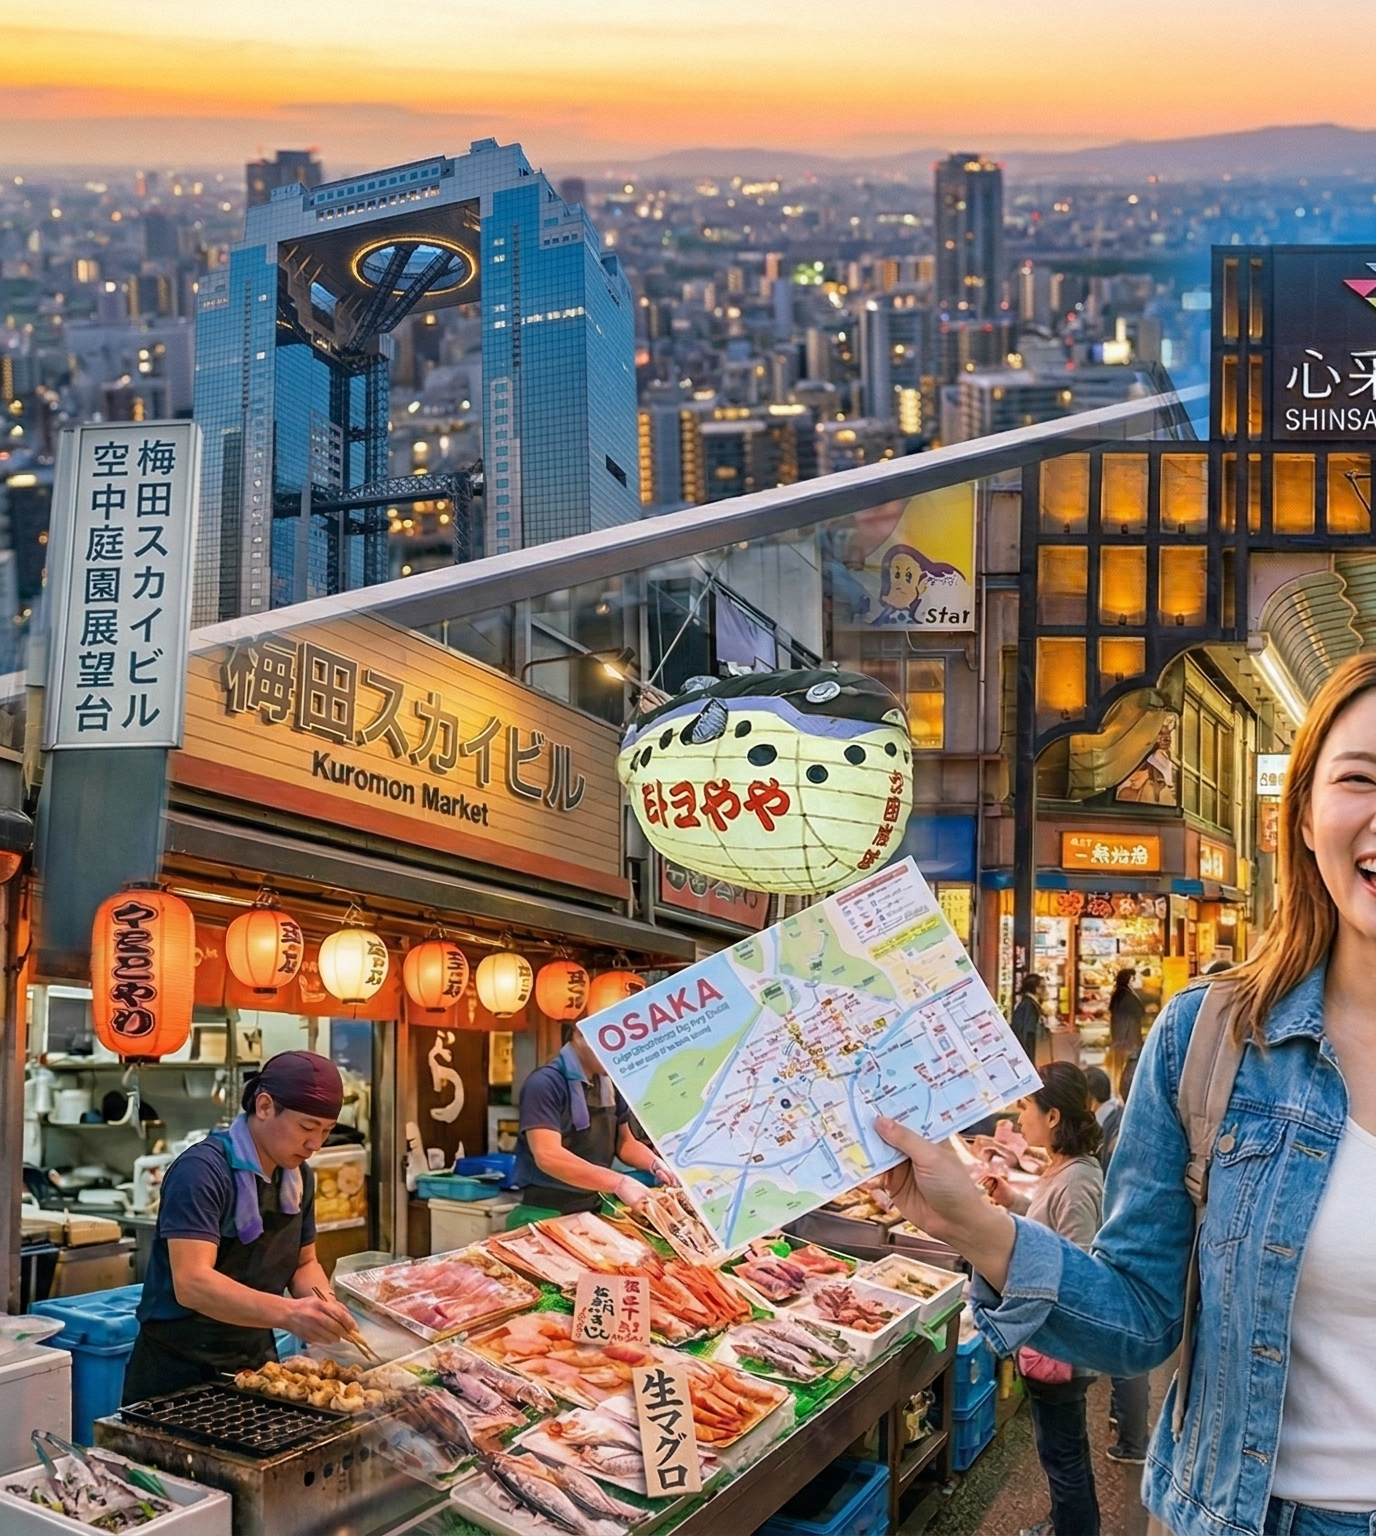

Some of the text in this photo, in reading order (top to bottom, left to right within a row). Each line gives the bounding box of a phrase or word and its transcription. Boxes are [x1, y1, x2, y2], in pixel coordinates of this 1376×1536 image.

[75, 441, 130, 734] 空中庭園展望台
[121, 439, 176, 729] 梅田スカイビル
[925, 606, 971, 624] Star
[312, 750, 490, 827] Kuromon Market
[598, 978, 725, 1052] OSAKA
[640, 1366, 688, 1491] 生マグロ
